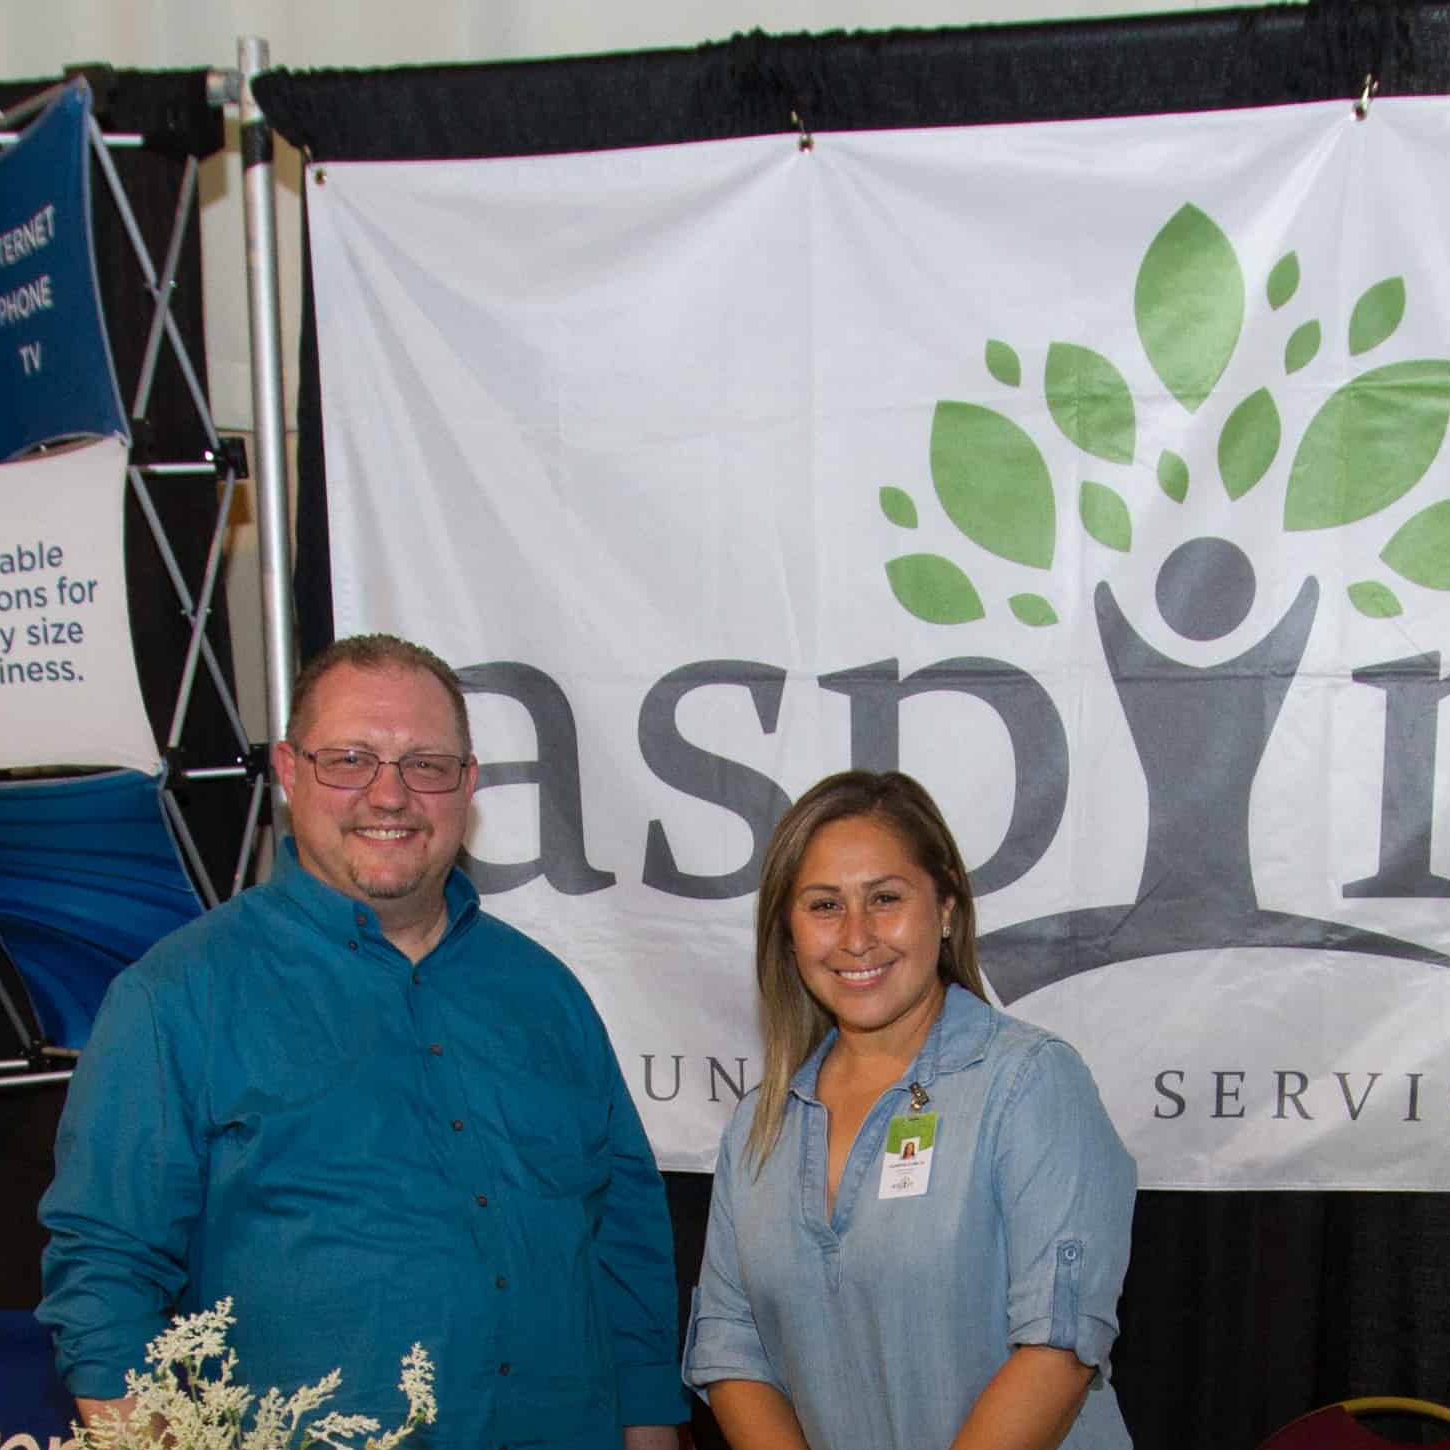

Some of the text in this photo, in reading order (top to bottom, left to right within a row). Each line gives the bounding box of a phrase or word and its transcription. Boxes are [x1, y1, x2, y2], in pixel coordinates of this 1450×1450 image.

[18, 344, 43, 375] TV
[56, 574, 100, 605] for
[25, 617, 85, 646] size
